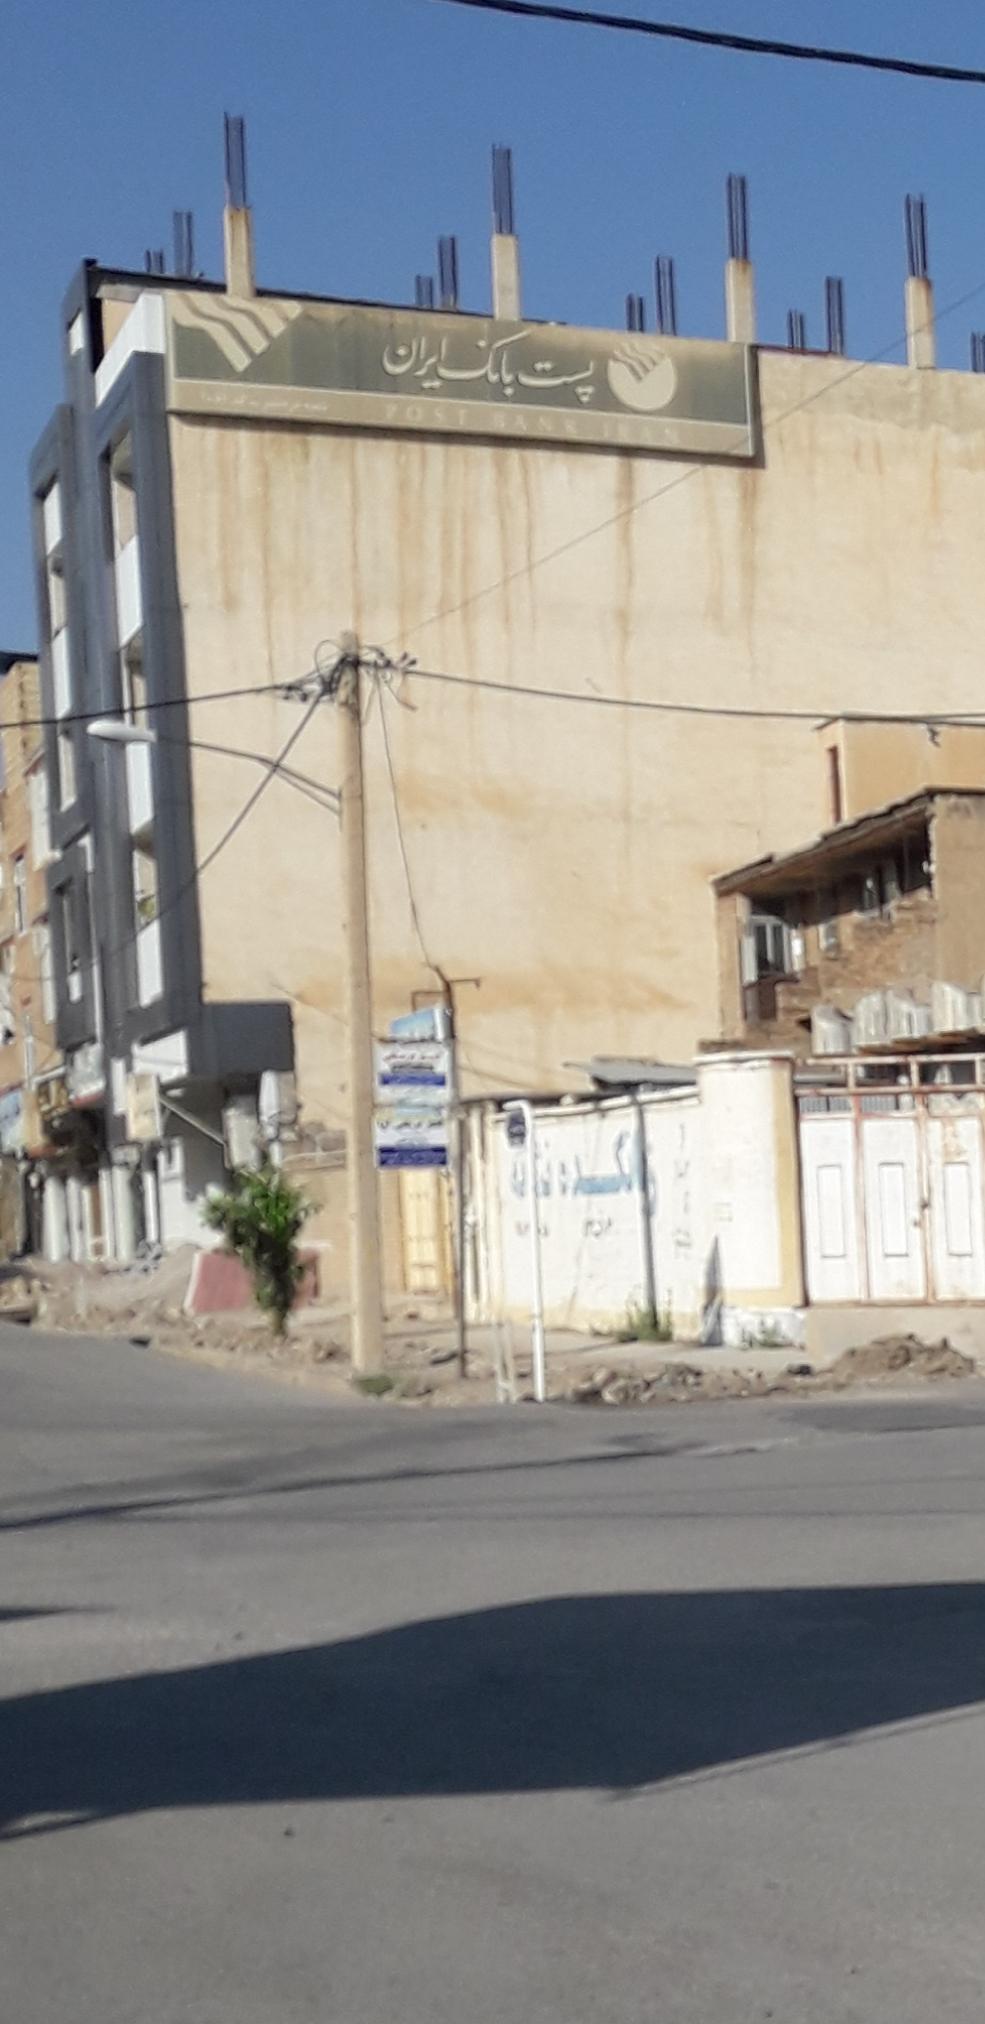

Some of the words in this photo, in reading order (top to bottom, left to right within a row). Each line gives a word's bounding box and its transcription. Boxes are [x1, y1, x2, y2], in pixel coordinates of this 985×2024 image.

[382, 336, 448, 389] ایران
[436, 329, 532, 397] بانک
[518, 360, 595, 404] پست
[385, 403, 468, 425] POST
[492, 411, 577, 435] BANK
[602, 421, 680, 446] IRAN
